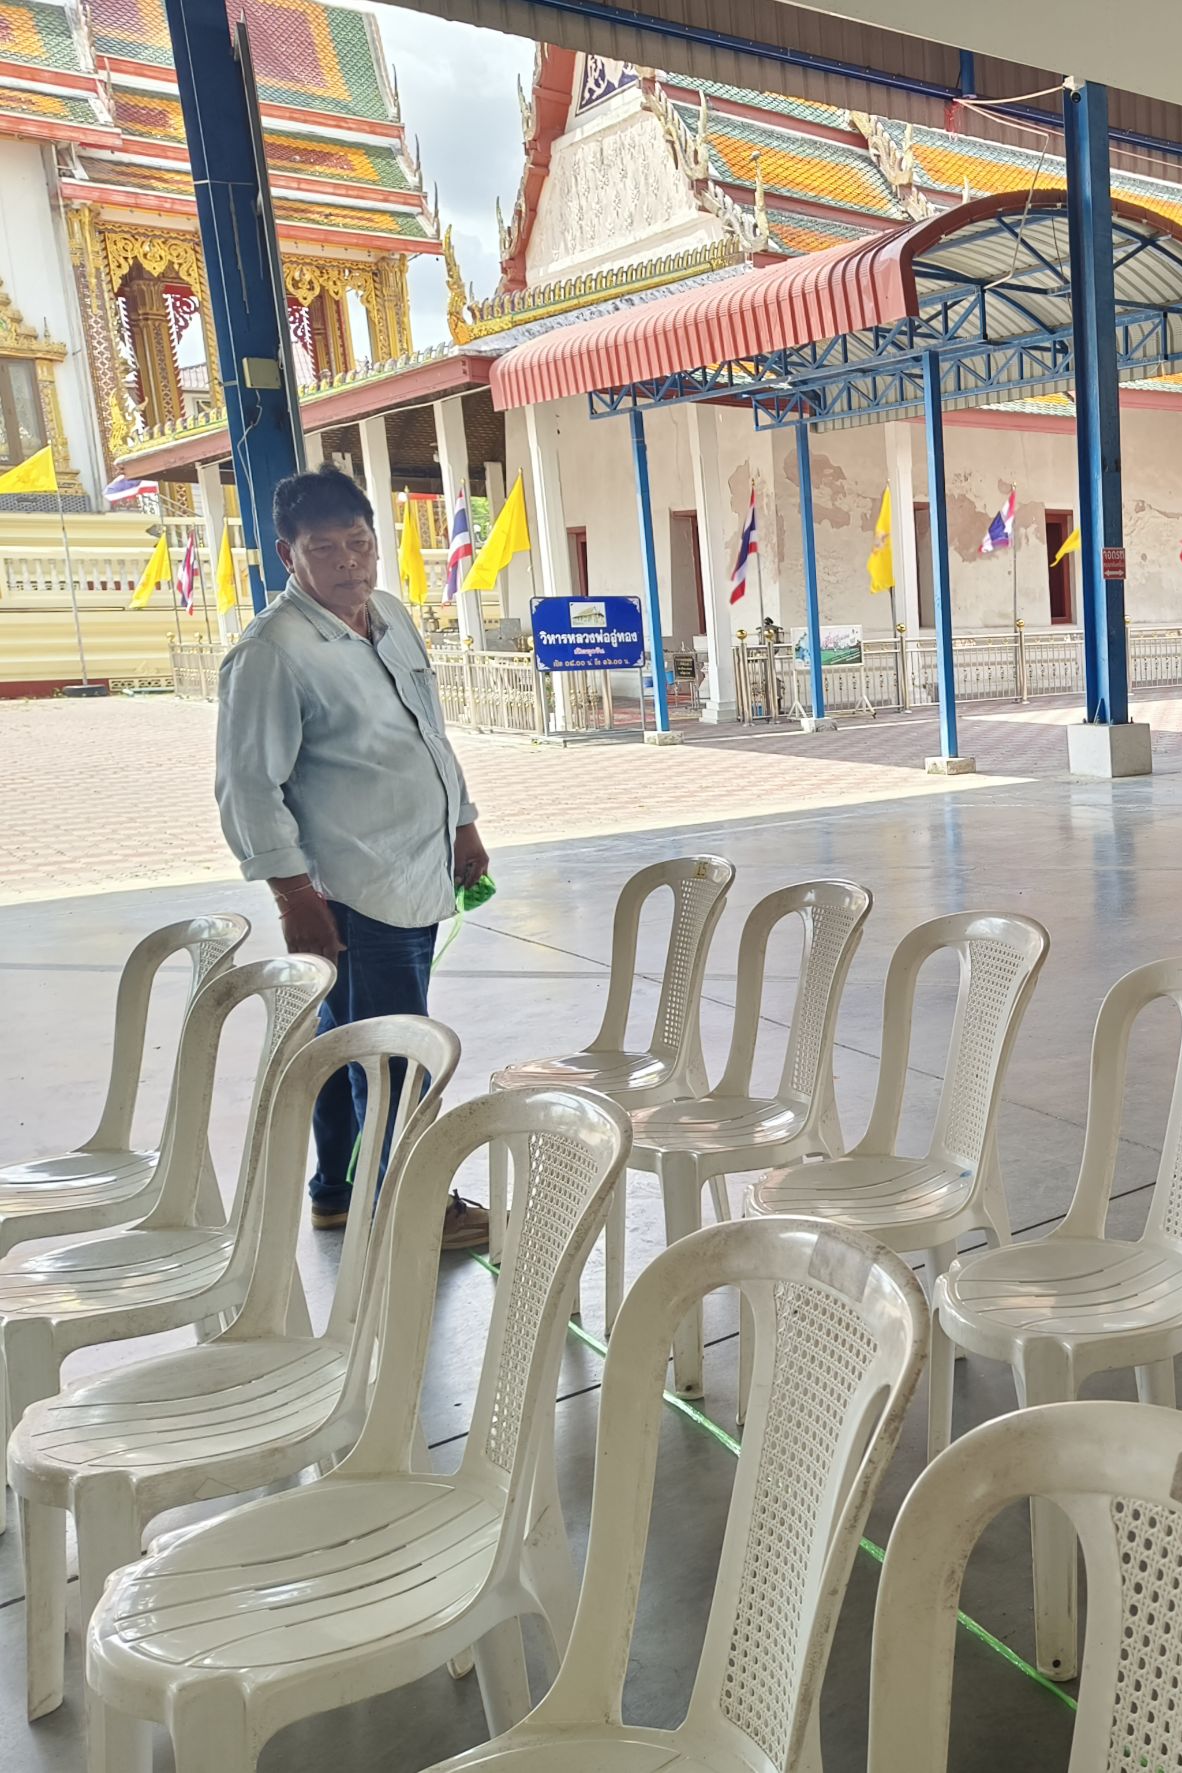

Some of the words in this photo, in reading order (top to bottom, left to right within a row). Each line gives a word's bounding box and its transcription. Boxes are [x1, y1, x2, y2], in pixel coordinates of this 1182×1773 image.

[539, 628, 638, 647] วิหารหลวงพ่ออู่ทอง
